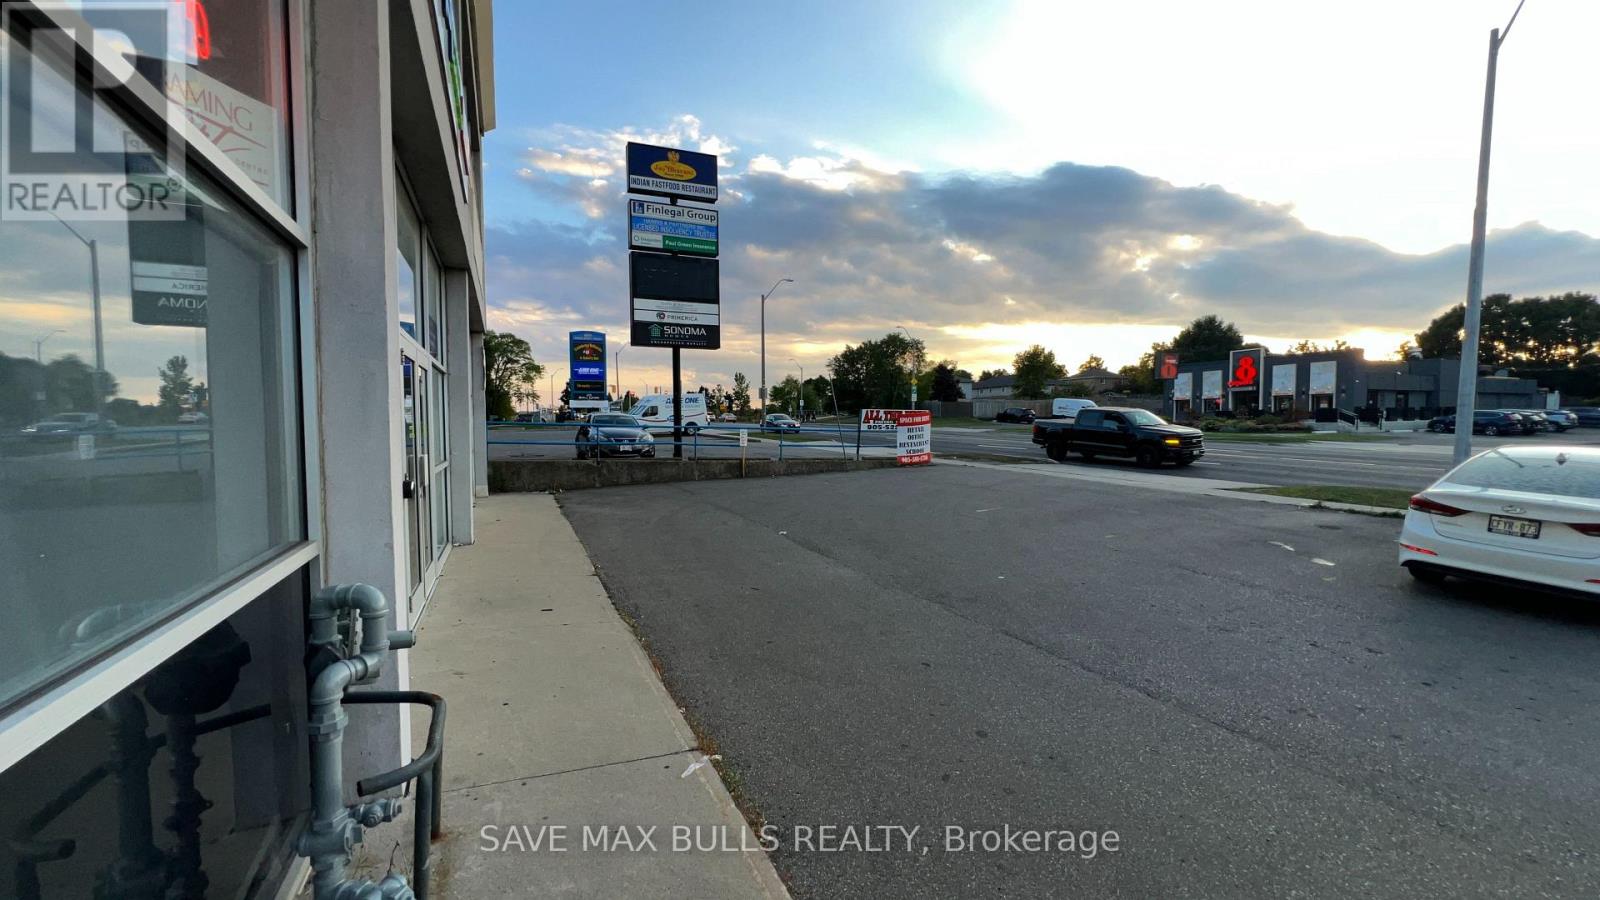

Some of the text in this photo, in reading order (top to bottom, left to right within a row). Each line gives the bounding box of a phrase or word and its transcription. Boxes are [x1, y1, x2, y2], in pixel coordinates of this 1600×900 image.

[167, 72, 253, 131] AMING
[630, 176, 716, 196] INDIAN FASTFOOD RESTAURANT
[646, 204, 716, 222] Finlegal Group
[667, 314, 698, 322] PRIMERICA
[664, 325, 707, 336] SONOMA
[684, 396, 700, 404] ONE
